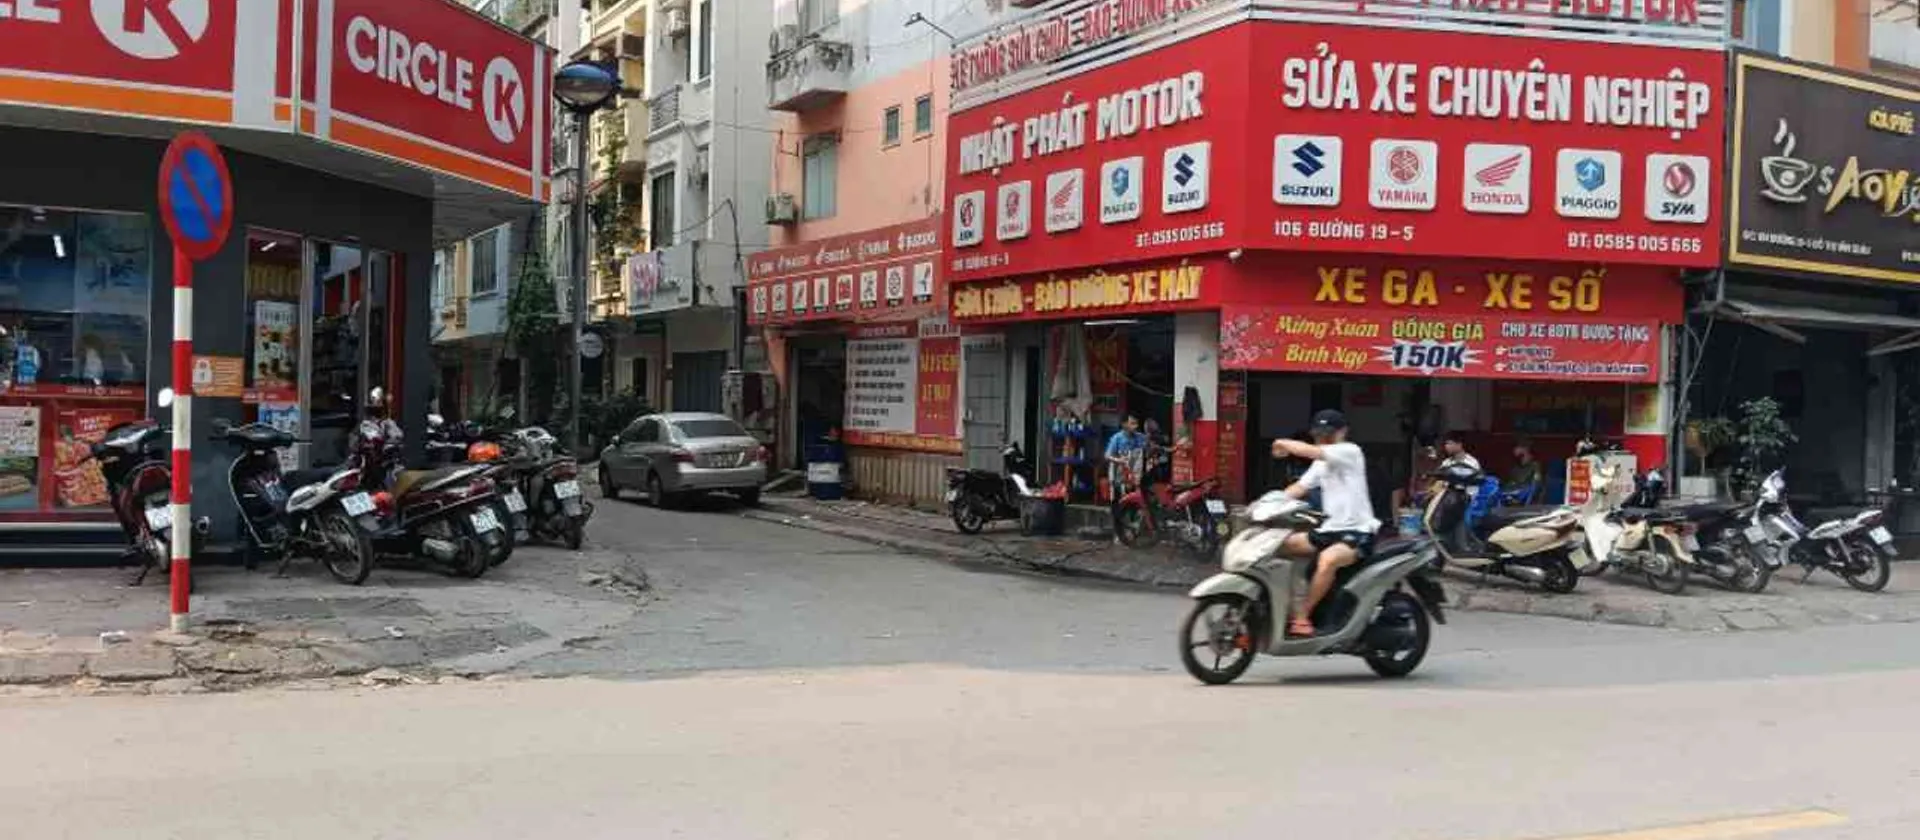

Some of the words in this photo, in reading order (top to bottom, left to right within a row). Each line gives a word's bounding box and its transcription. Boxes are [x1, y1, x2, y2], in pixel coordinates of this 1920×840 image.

[345, 14, 472, 112] CIRCLE
[488, 64, 522, 139] K
[1282, 42, 1360, 110] SỬA
[1370, 61, 1418, 113] XE
[1428, 57, 1572, 122] CHUYÊN
[1584, 66, 1711, 140] NGHIỆP
[1022, 90, 1090, 160] PHÁT
[1095, 70, 1204, 142] MOTOR
[1280, 184, 1334, 199] SUZUKI
[1378, 188, 1429, 205] YAMAHA
[1470, 191, 1525, 206] HONDA
[1560, 195, 1618, 211] PIAGGIO
[1660, 201, 1696, 216] SYM
[1403, 225, 1414, 241] 5
[1594, 232, 1635, 250] 0585
[1638, 235, 1669, 252] 005
[1671, 236, 1702, 253] 666
[1131, 271, 1159, 304] XE
[1160, 259, 1204, 301] MÁY
[1314, 267, 1368, 304] XE
[1382, 269, 1439, 306] GA
[1454, 285, 1466, 294] -
[1483, 272, 1534, 310] XE
[1548, 267, 1608, 313] SỐ
[1329, 316, 1380, 337] Xuân
[1529, 323, 1546, 338] XE
[1392, 344, 1466, 369] 150K
